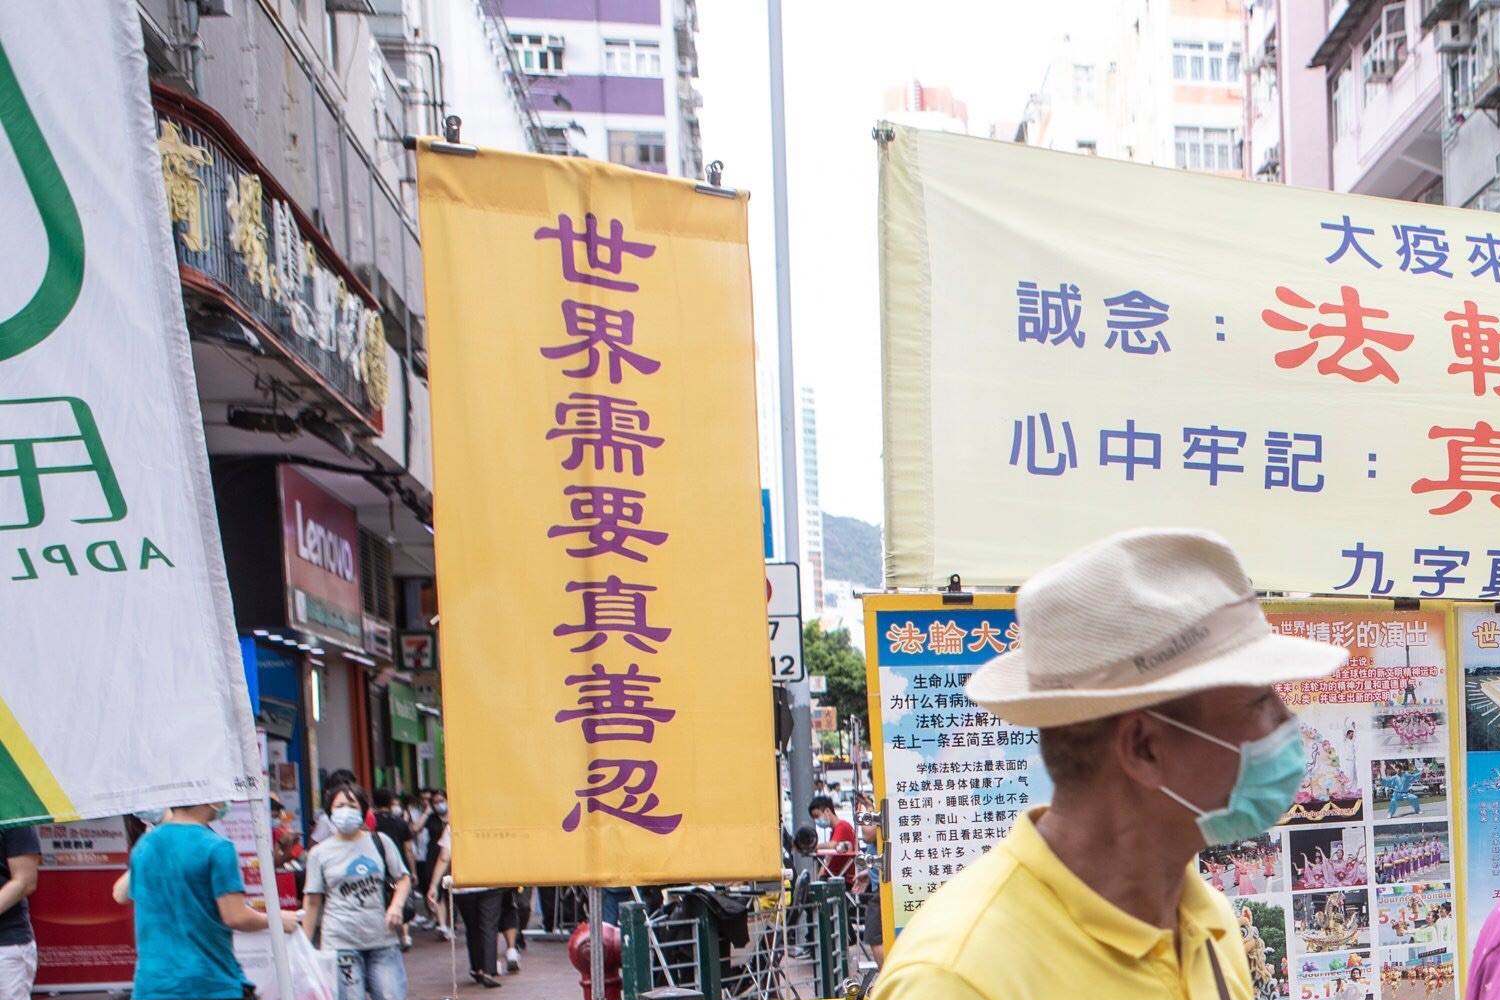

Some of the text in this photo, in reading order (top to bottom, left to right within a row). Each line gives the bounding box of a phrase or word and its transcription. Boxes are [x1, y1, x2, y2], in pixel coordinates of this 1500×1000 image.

[296, 500, 354, 583] Lenovo
[534, 212, 683, 835] 世界需要真善忍
